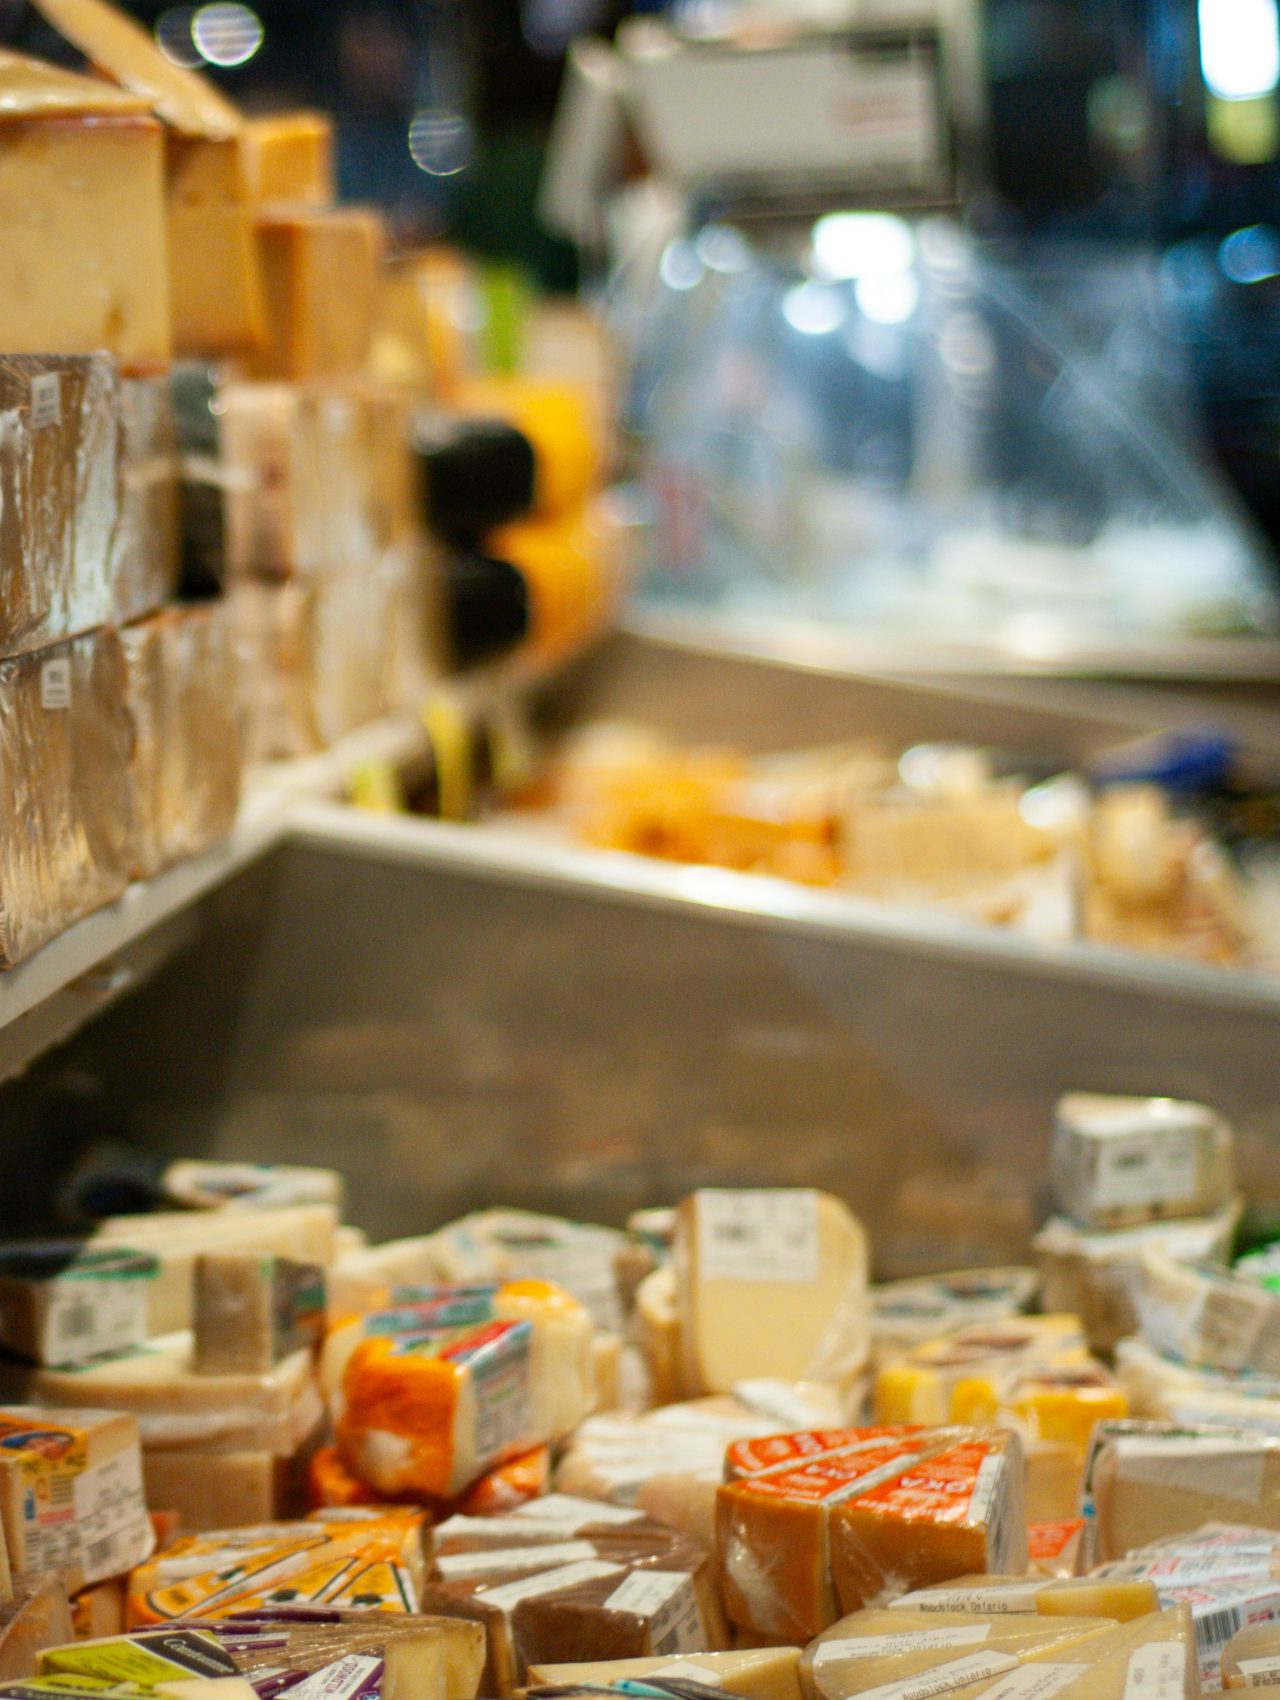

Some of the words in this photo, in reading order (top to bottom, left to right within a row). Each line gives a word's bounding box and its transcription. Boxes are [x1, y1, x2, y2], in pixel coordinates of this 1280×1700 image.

[900, 1475, 968, 1493] OKA
[919, 1602, 966, 1613] Woodstock
[971, 1601, 1008, 1612] Ontario
[322, 1662, 359, 1694] WILDWOOD
